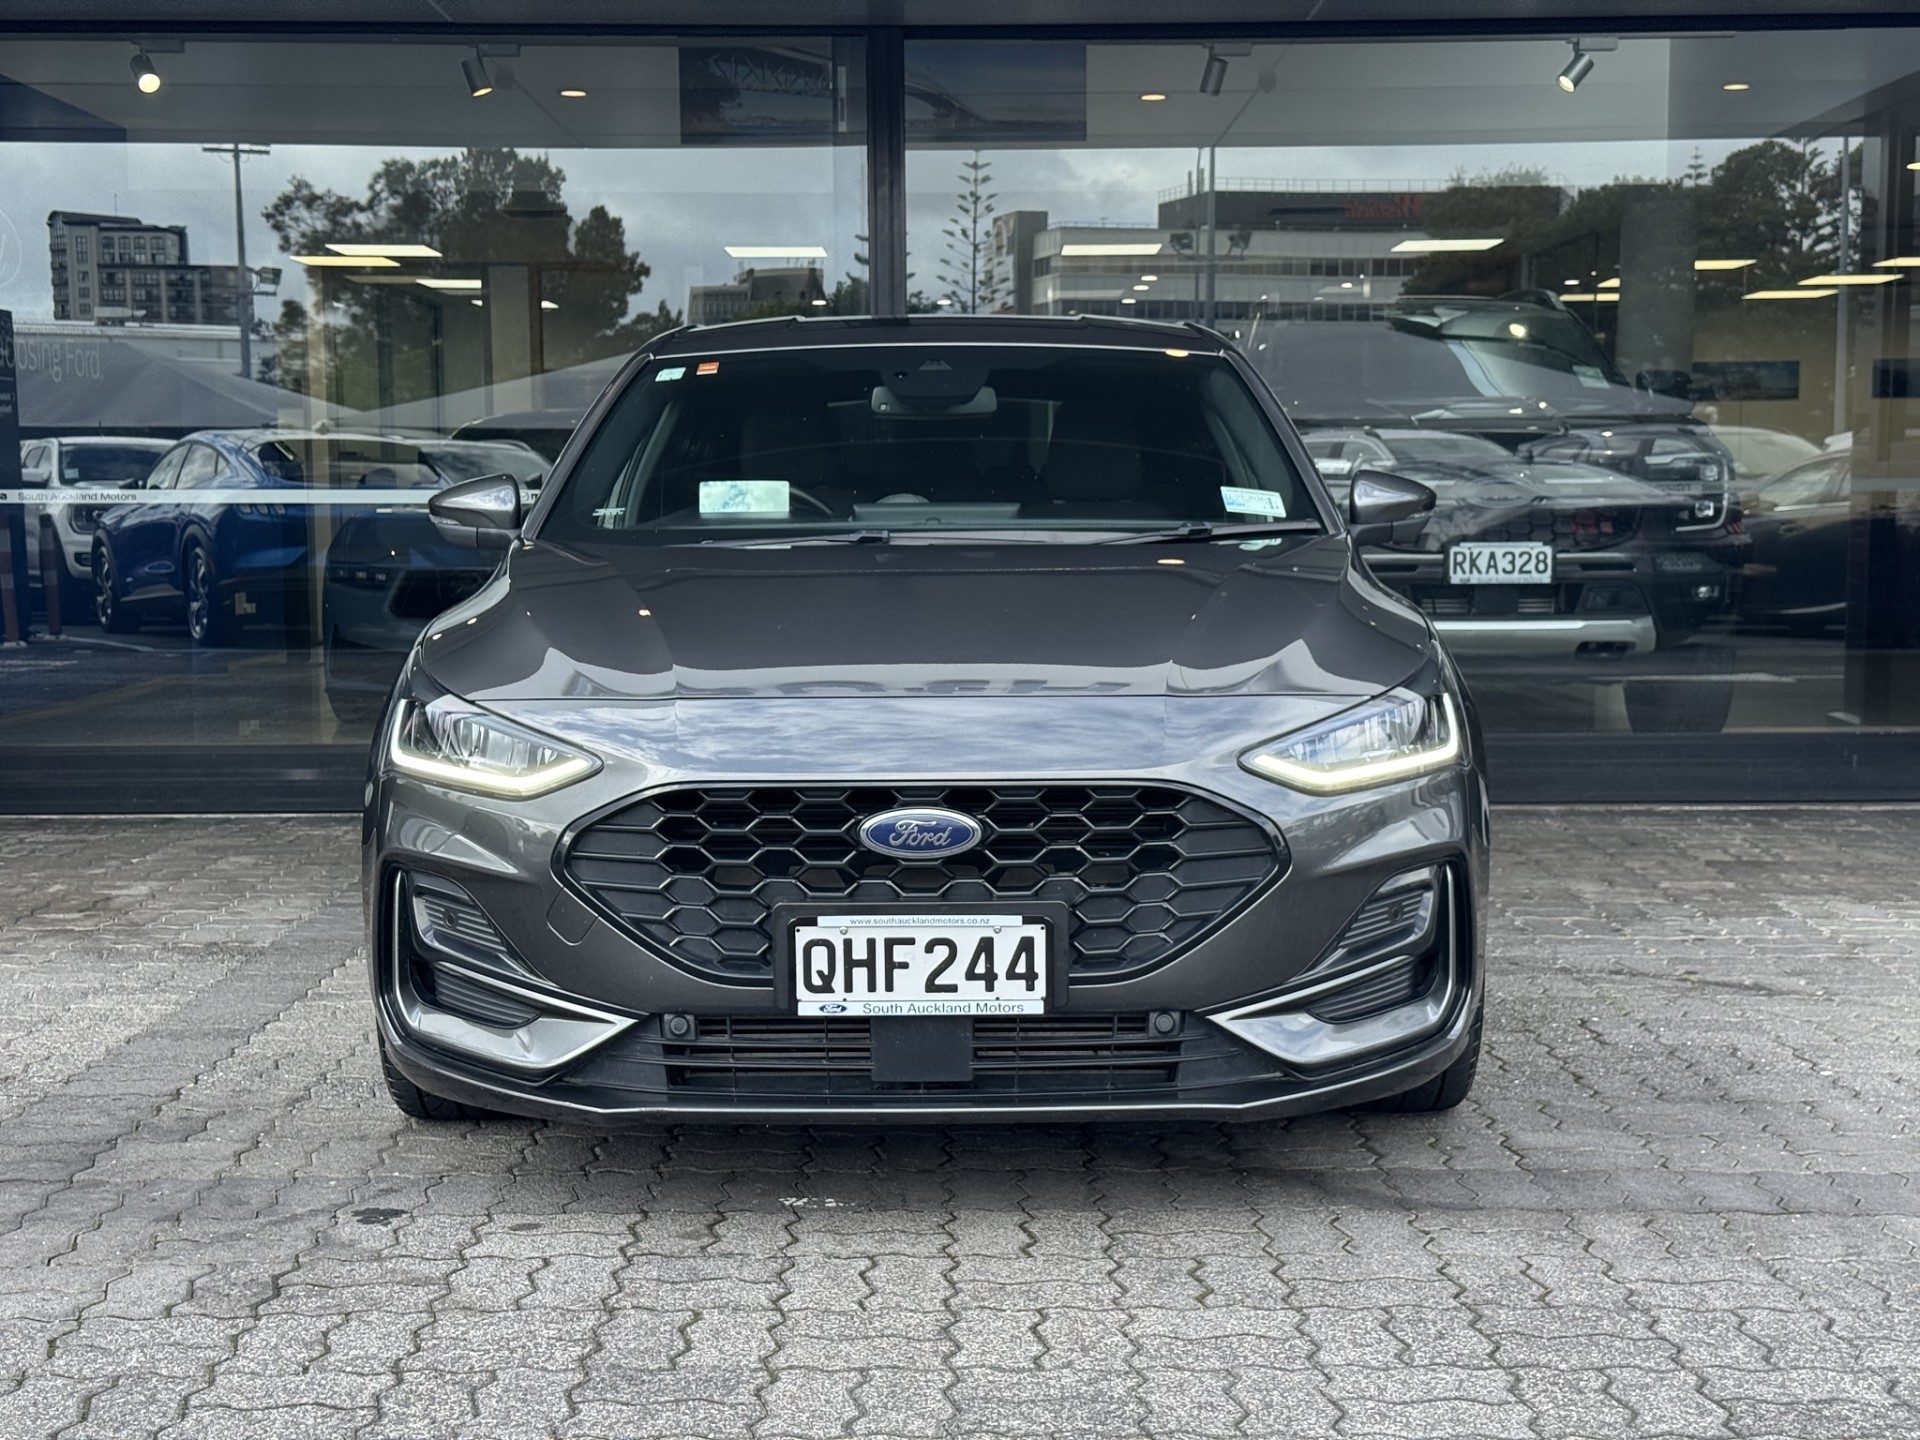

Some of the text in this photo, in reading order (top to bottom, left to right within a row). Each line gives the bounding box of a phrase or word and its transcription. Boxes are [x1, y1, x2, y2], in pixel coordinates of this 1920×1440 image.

[18, 492, 47, 501] South
[101, 492, 136, 501] Motors
[1452, 551, 1548, 574] RKA328
[889, 819, 952, 847] Ford
[850, 917, 990, 925] www.southaucklandmotors.co.nz
[802, 936, 1039, 994] QHF244
[863, 1003, 903, 1014] South
[907, 1003, 971, 1014] Auckland
[976, 1002, 1024, 1013] Motors
